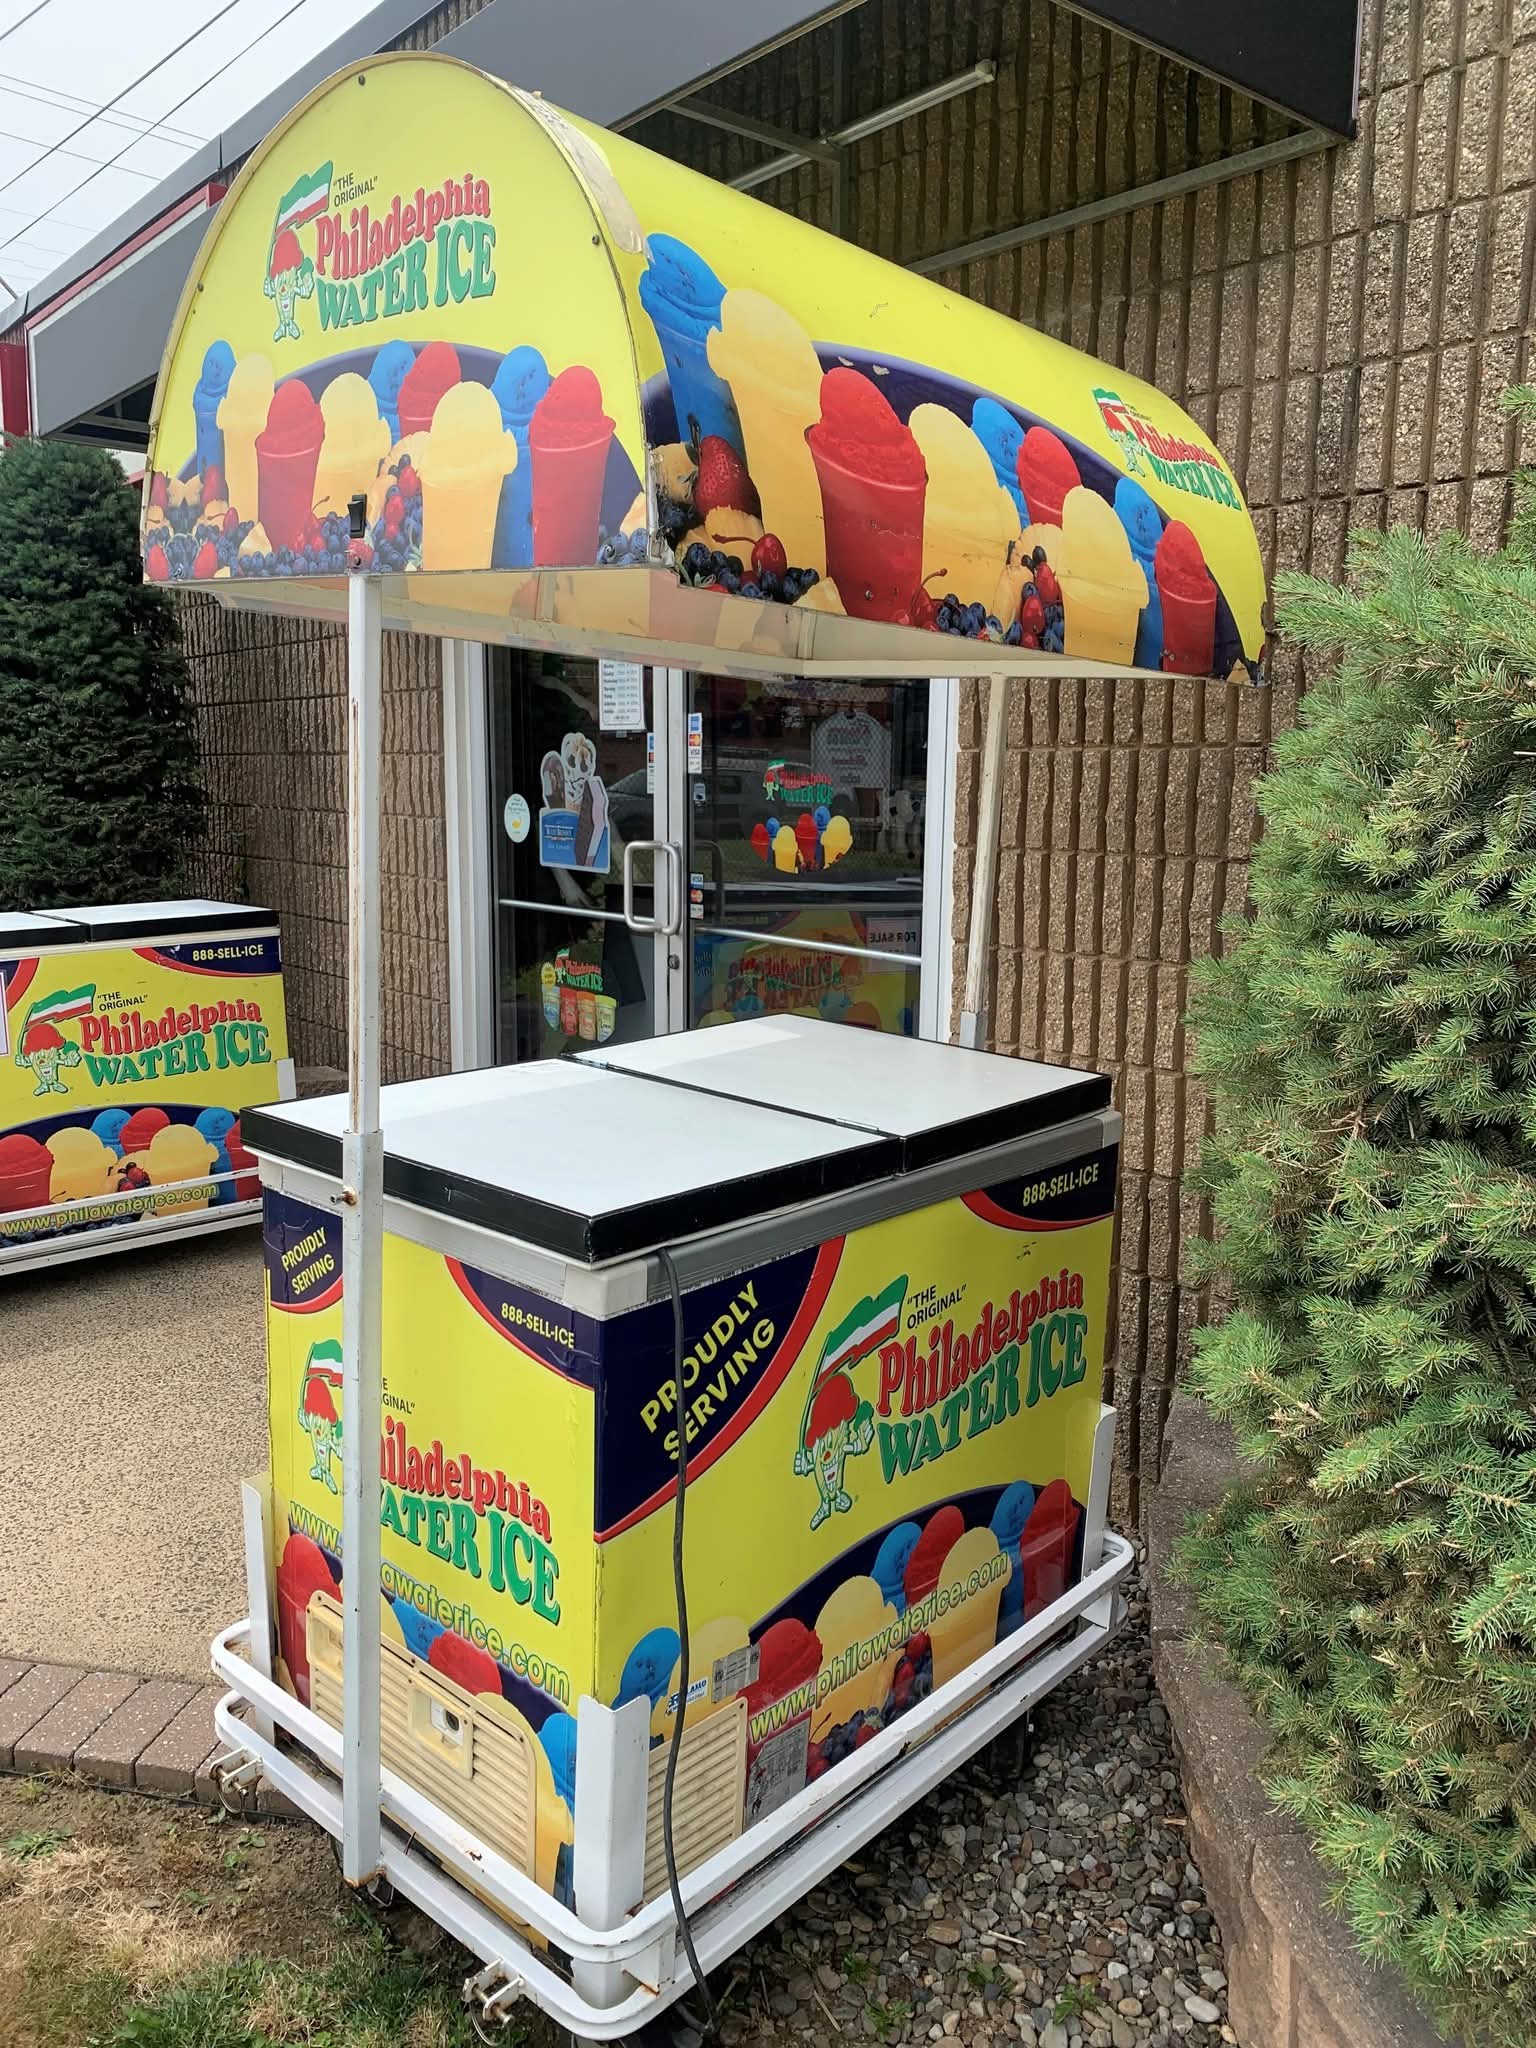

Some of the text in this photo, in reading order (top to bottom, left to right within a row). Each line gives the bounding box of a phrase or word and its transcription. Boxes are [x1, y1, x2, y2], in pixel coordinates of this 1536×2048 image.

[334, 175, 378, 207] ORIGINAL"
[315, 173, 492, 280] Philadelphia
[316, 219, 496, 331] WATER ICE
[1125, 414, 1223, 472] Philadelphia
[1143, 450, 1242, 511] WATER ICE
[192, 944, 264, 961] 888-SELL-ICE
[97, 991, 121, 1002] "THE
[99, 994, 149, 1012] ORIGINAL"
[79, 999, 262, 1056] Philadelphia
[83, 1022, 272, 1087] WATER ICE
[4, 1183, 220, 1236] www.philawaterice.com
[1022, 1163, 1100, 1207] 888-SELL-ICE
[281, 1226, 327, 1273] PROUDLY
[292, 1252, 336, 1296] SERVING
[907, 1285, 938, 1306] "THE
[907, 1283, 967, 1329] ORIGINAL"
[500, 1302, 575, 1350] 888-SELL-ICE
[875, 1267, 1084, 1417] Philadelphia
[639, 1279, 760, 1433] PROUDLY
[381, 1391, 416, 1414] GINAL"
[663, 1318, 776, 1461] SERVING
[877, 1312, 1089, 1484] WATER ICE
[380, 1415, 551, 1543] iladelphia
[380, 1485, 560, 1626] ATER ICE
[289, 1500, 571, 1706] www.awaterice.com
[750, 1551, 1009, 1744] www.philawaterice.com
